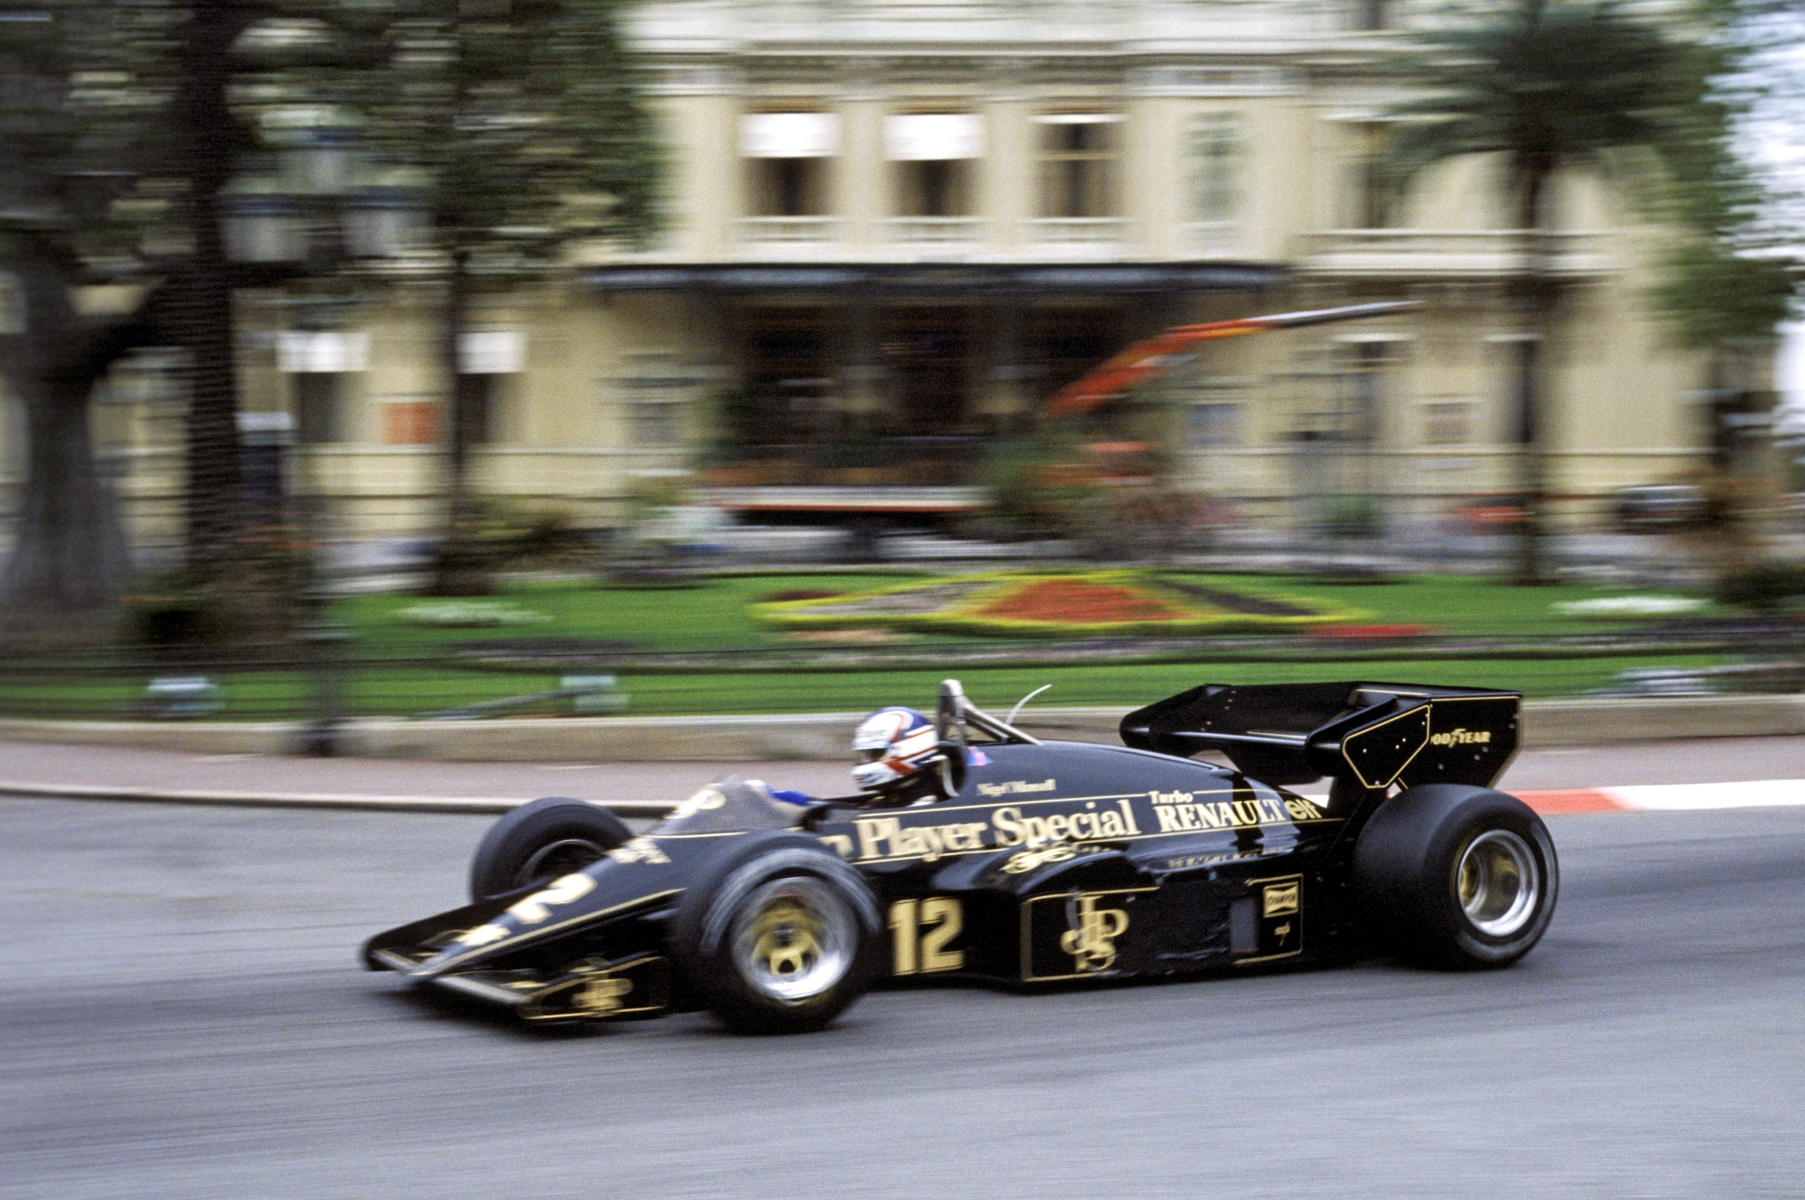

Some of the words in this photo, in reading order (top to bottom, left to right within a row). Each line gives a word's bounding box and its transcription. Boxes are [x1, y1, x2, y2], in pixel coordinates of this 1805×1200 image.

[1430, 728, 1491, 748] ODYEAR
[1149, 790, 1194, 804] Turbo
[1284, 799, 1322, 820] elf
[1153, 799, 1286, 833] RENAULT
[852, 817, 988, 862] Player
[991, 799, 1142, 849] Special
[887, 896, 965, 976] 12
